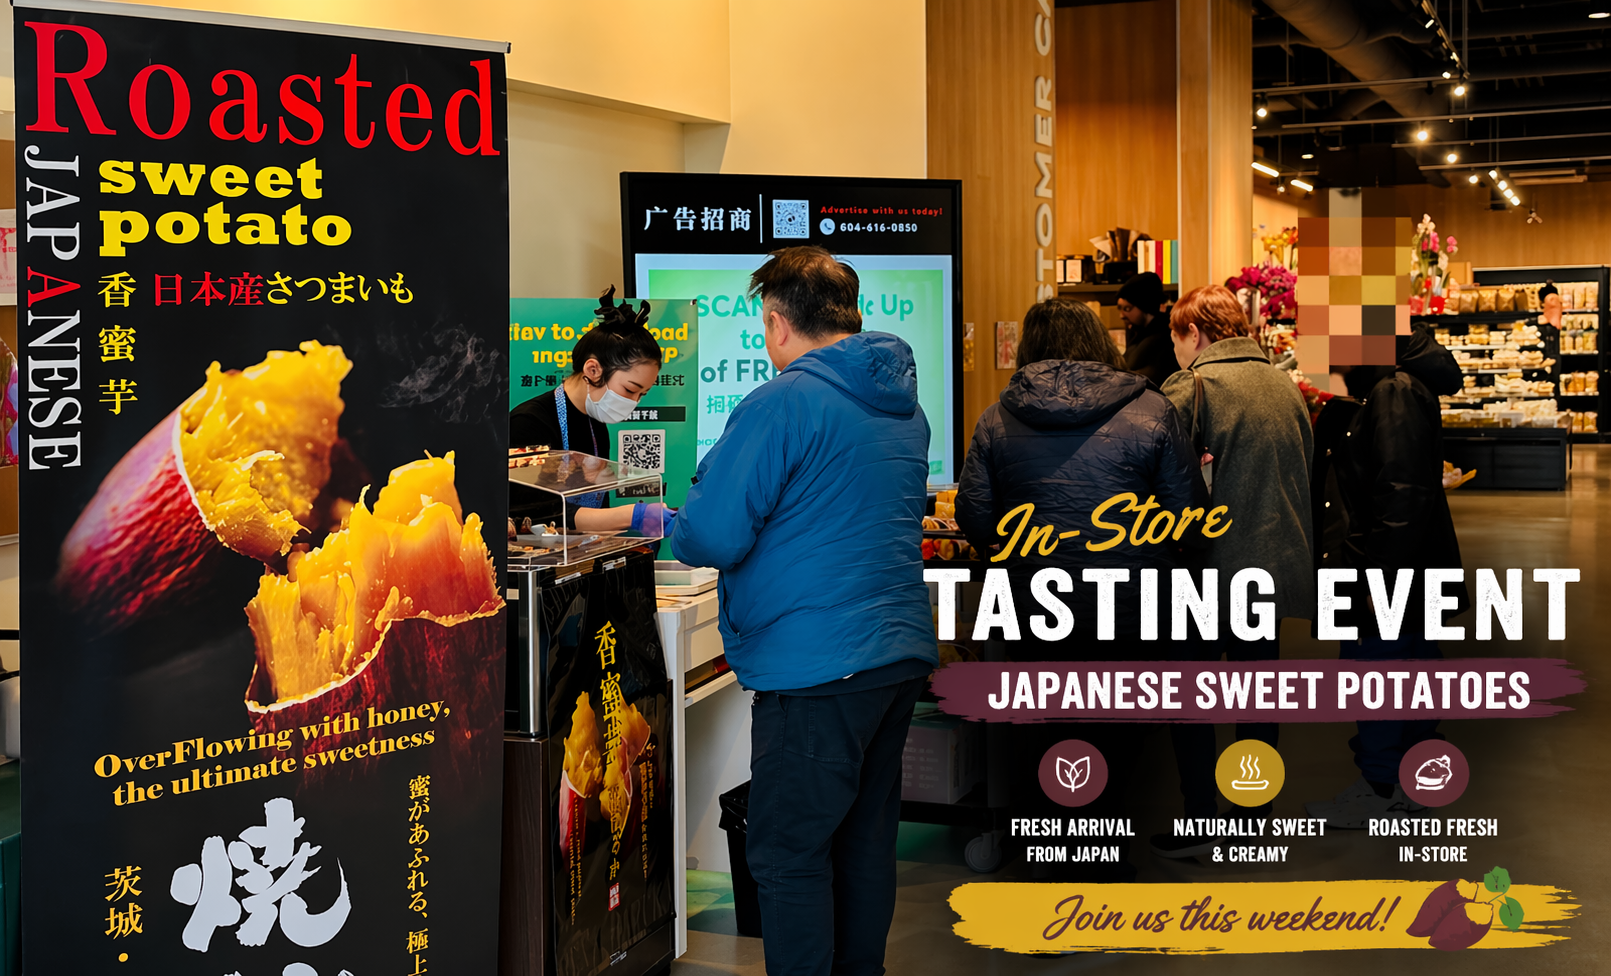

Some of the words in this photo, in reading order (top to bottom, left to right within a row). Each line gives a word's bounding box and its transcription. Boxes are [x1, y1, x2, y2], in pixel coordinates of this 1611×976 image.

[24, 21, 500, 156] Roasted
[98, 157, 323, 199] sweet
[1034, 76, 1053, 303] STOMER
[98, 201, 352, 257] potato
[643, 206, 752, 231] 广告招商
[873, 206, 894, 215] with
[912, 207, 943, 217] today!
[24, 144, 82, 470] JAPANESE
[154, 271, 414, 307] 日本産さつまいも
[881, 293, 914, 321] Up
[98, 271, 137, 415] 香蜜芋
[550, 323, 575, 341] to
[740, 329, 766, 350] to
[701, 359, 728, 383] of
[93, 728, 294, 778] OverFlowing
[299, 705, 360, 741] with
[366, 700, 451, 722] honey,
[112, 780, 164, 806] the
[170, 755, 298, 795] ultimate
[303, 729, 435, 769] sweetness
[170, 797, 355, 976] 焼
